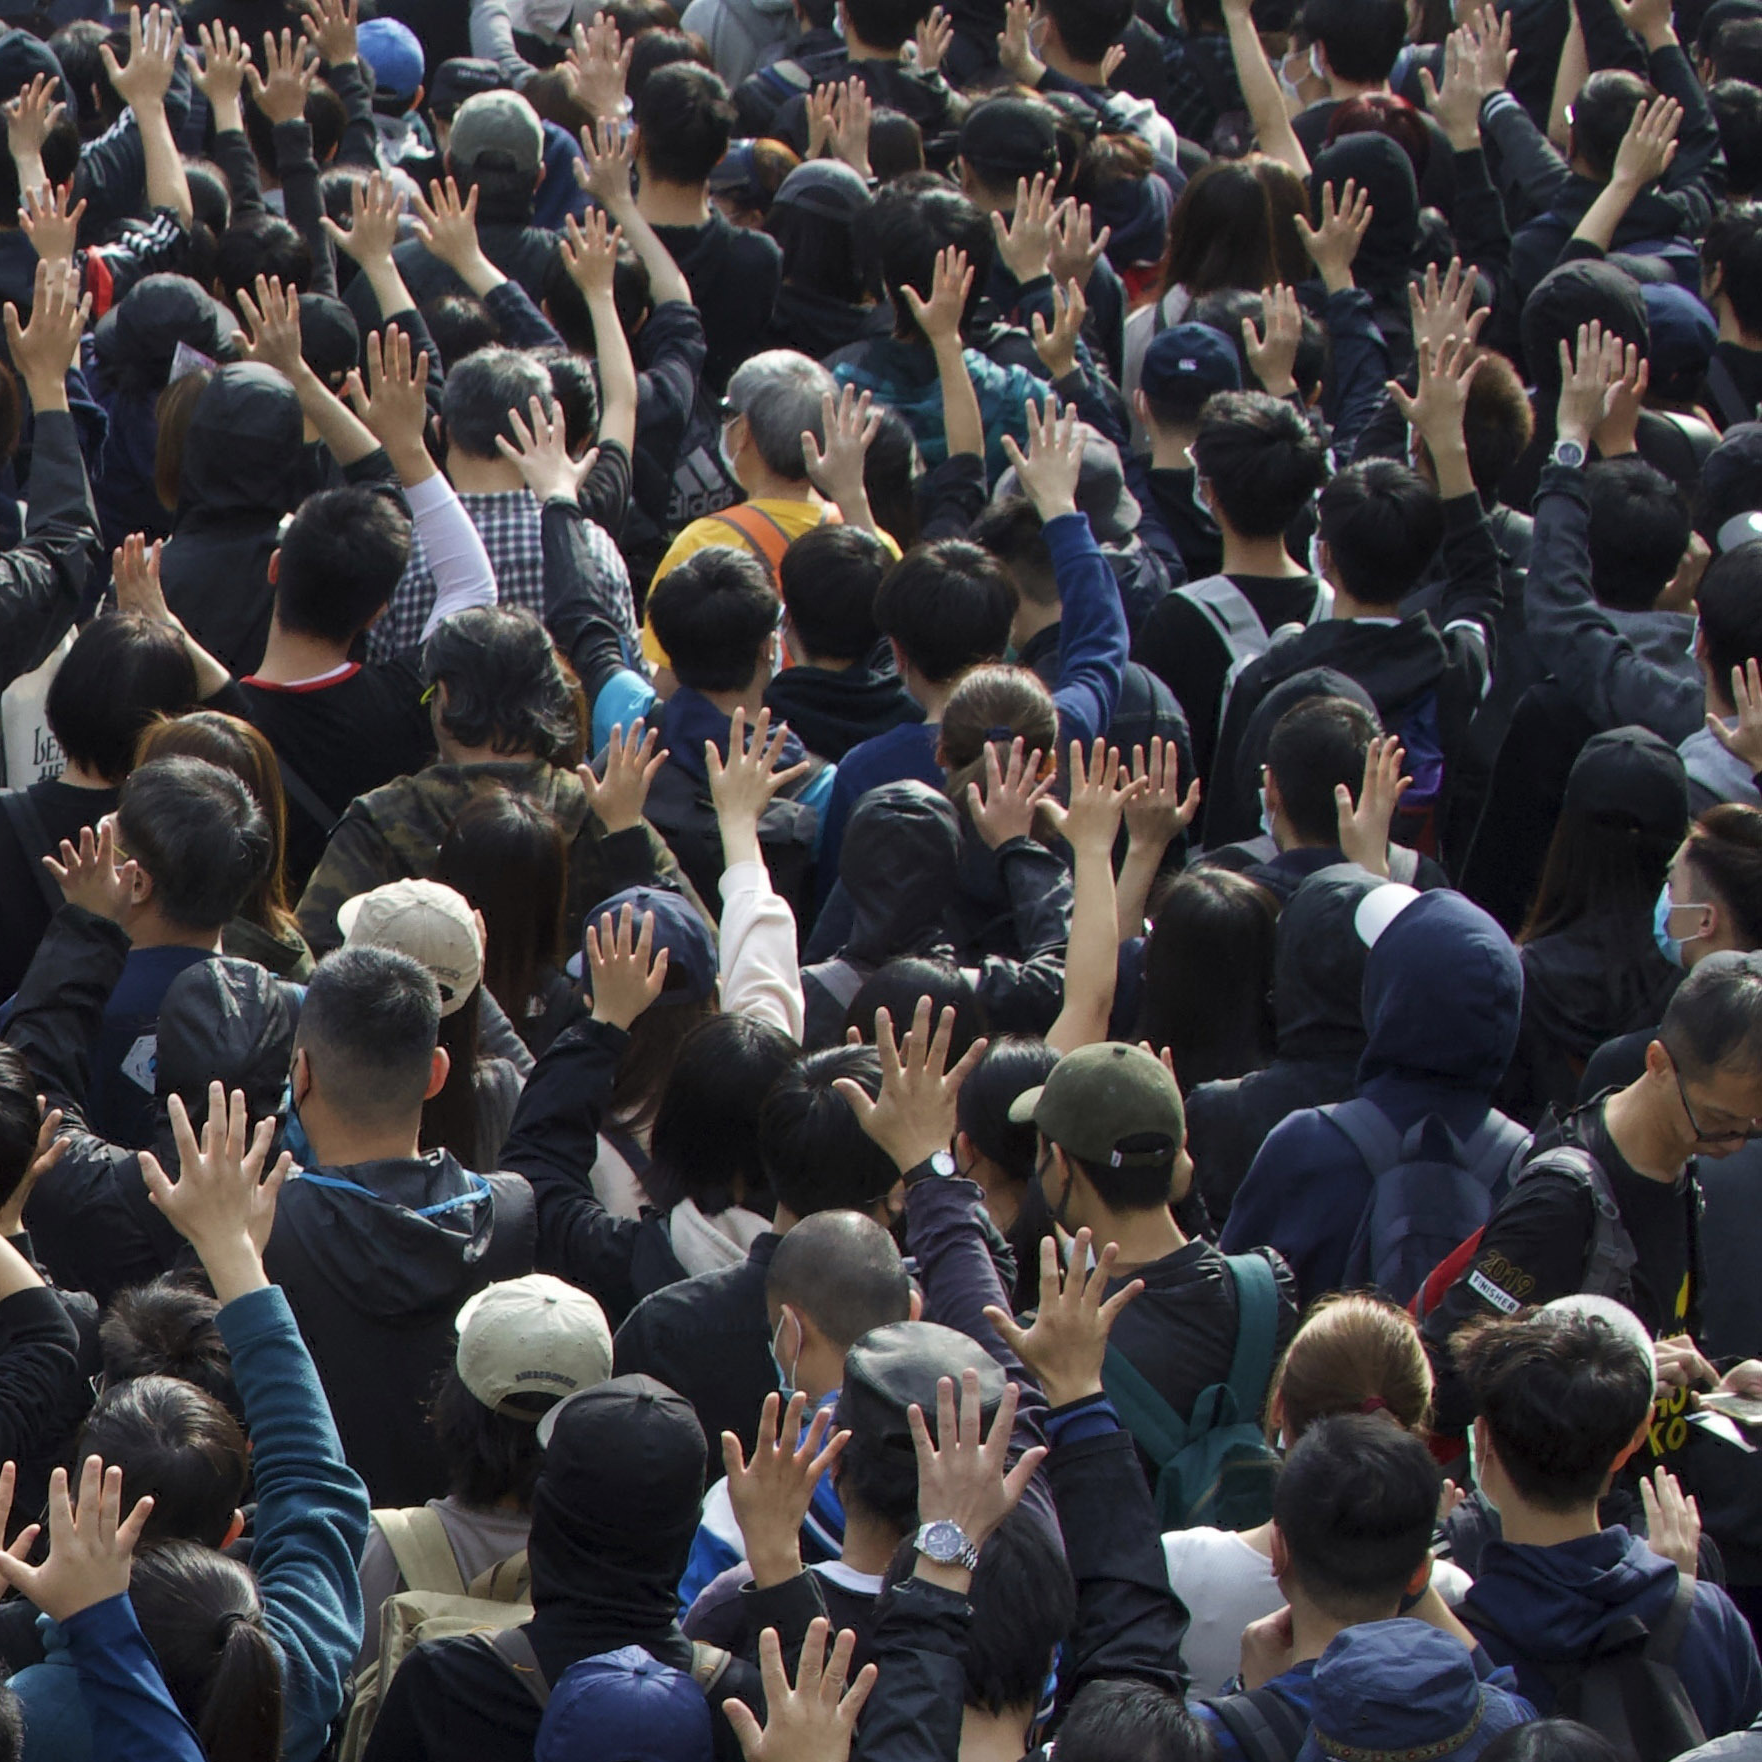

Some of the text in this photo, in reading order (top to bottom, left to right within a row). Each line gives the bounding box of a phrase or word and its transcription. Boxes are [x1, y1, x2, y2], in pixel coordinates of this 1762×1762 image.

[666, 485, 735, 520] didas
[1471, 1274, 1519, 1314] FINISHER
[1478, 1249, 1535, 1299] 2019
